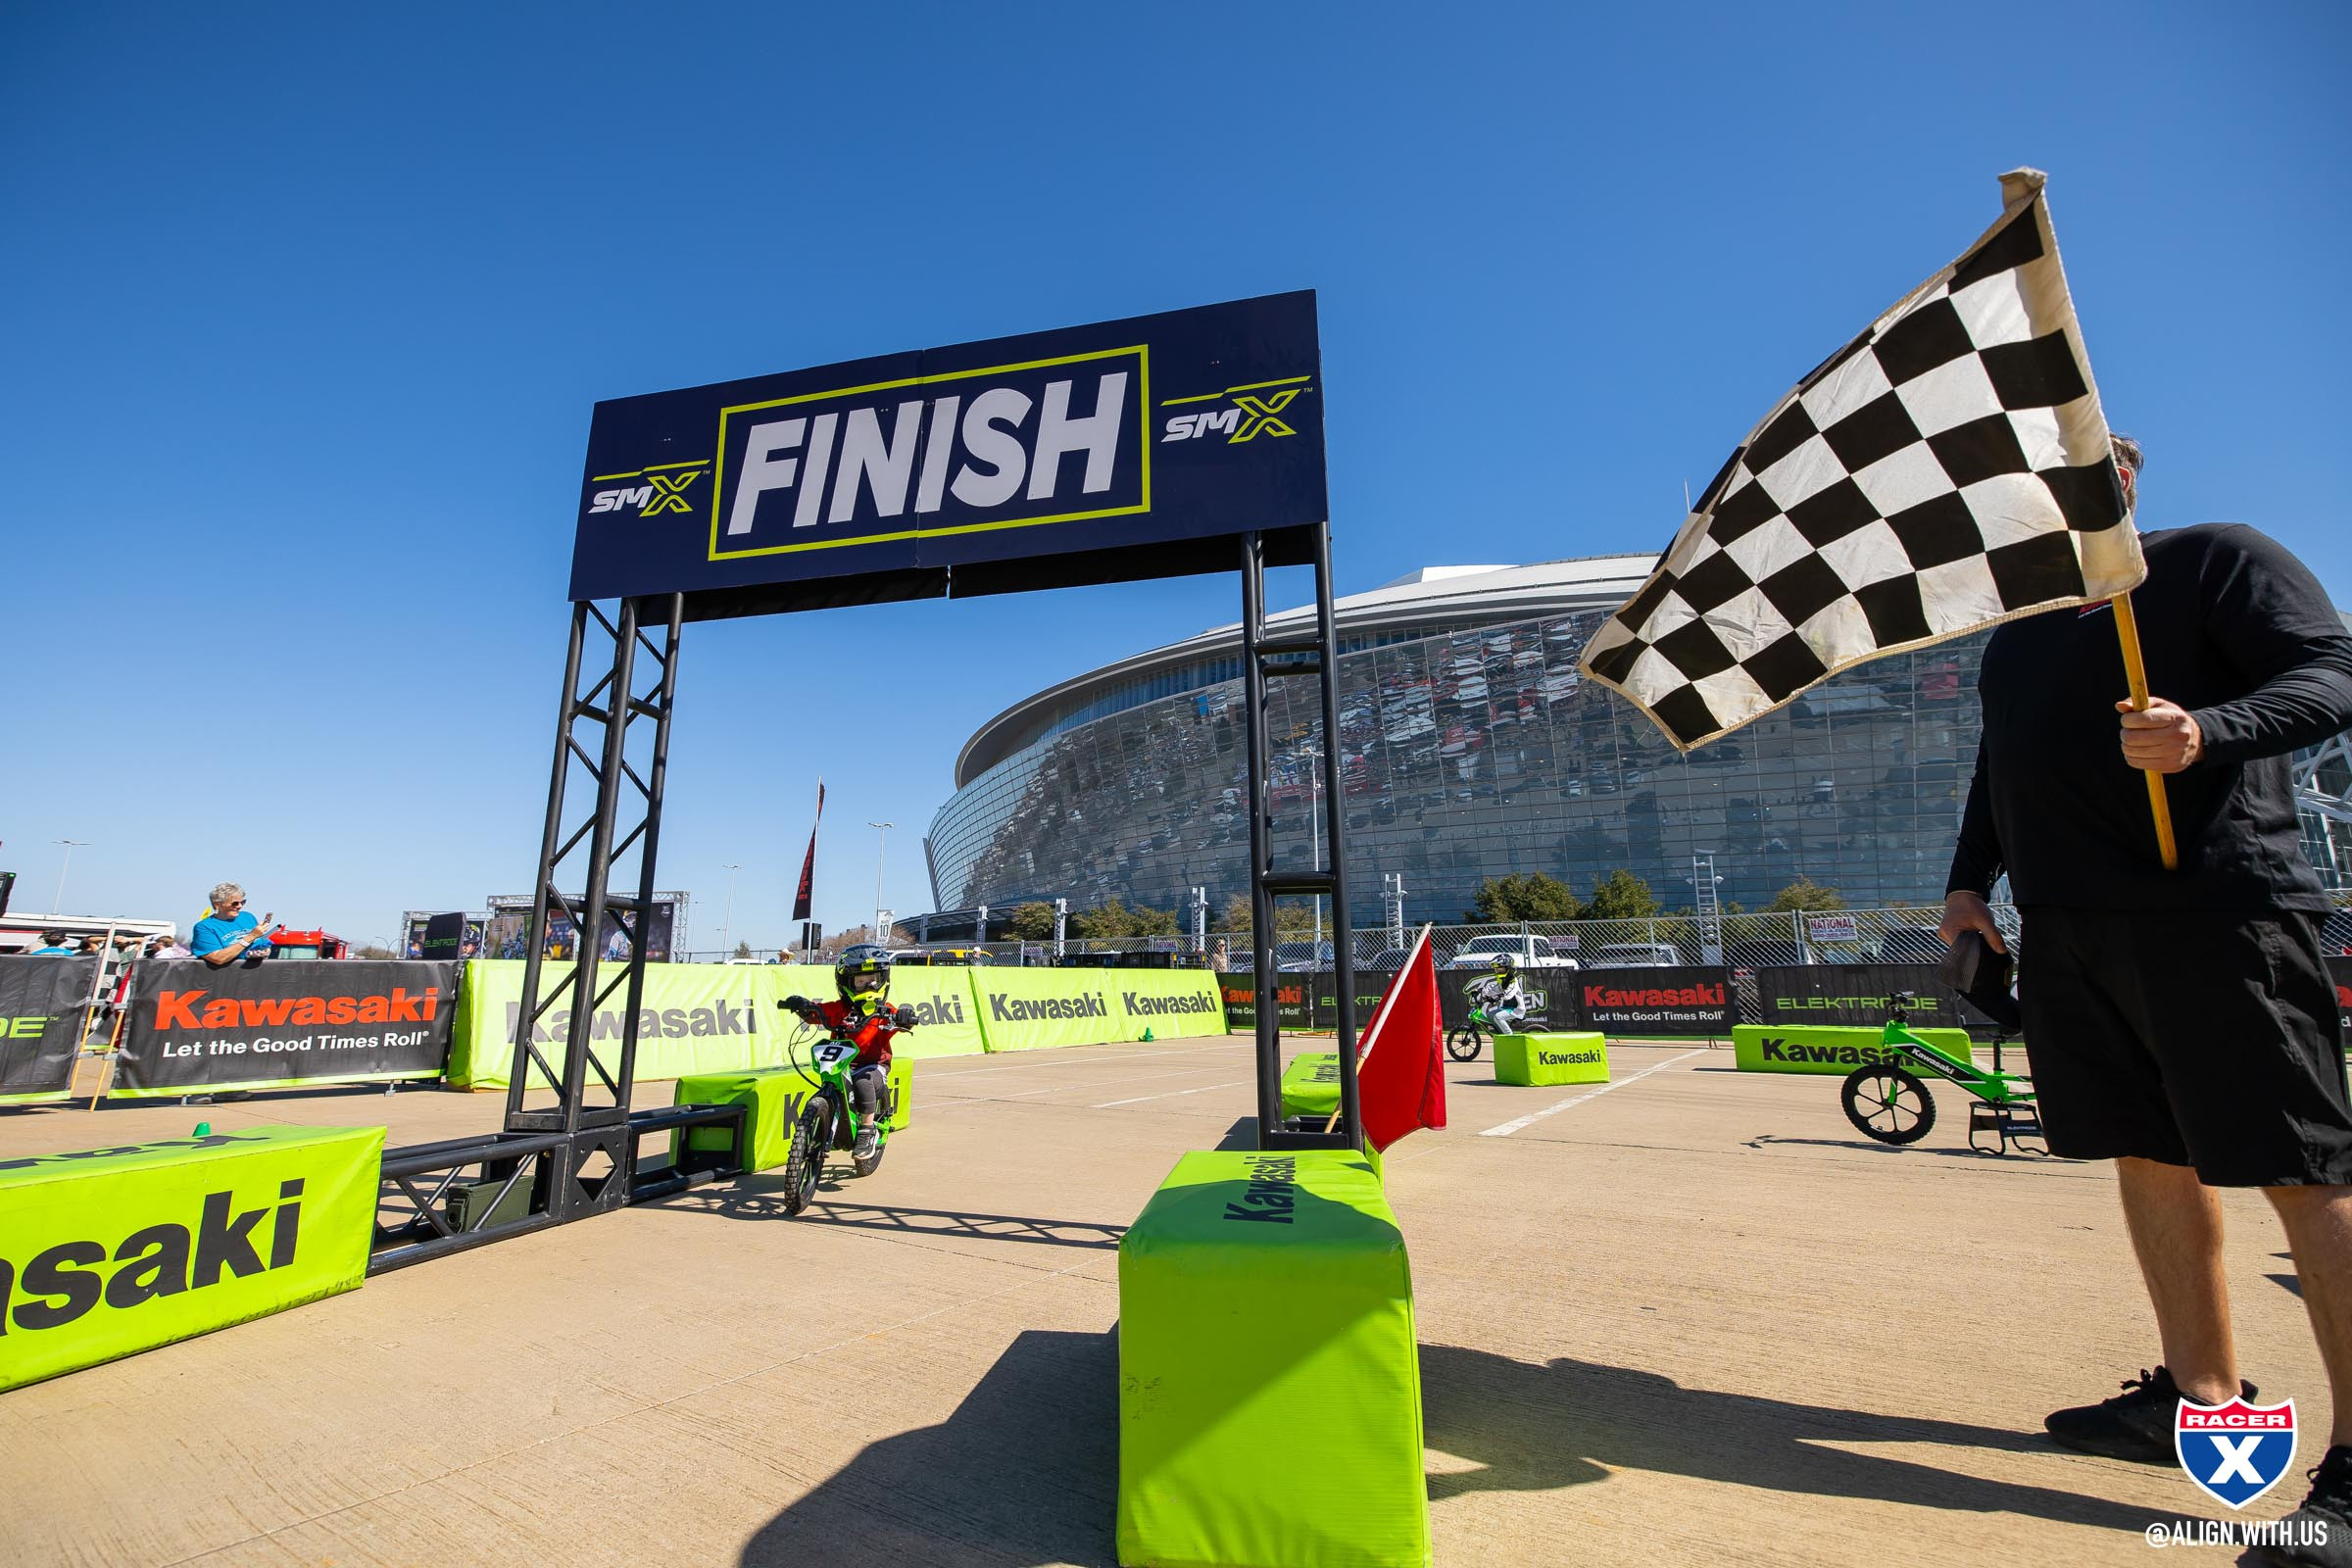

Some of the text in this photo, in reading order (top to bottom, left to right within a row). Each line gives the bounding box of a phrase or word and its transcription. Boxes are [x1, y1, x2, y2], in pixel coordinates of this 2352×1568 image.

[727, 371, 1128, 535] FINISH
[1811, 918, 1855, 930] NATIONAL
[989, 991, 1107, 1021] Kawasaki
[1122, 990, 1217, 1016] Kawasaki
[1584, 982, 1726, 1007] Kawasaki
[155, 987, 439, 1030] Kawasaki
[1593, 1012, 1610, 1021] Let
[1612, 1011, 1629, 1021] the
[1632, 1011, 1661, 1021] Good
[1663, 1011, 1697, 1021] Times
[163, 1041, 202, 1058] Let
[209, 1040, 246, 1055] the
[253, 1036, 312, 1053] Good
[318, 1034, 379, 1050] Times
[820, 1046, 843, 1062] 9
[1539, 1050, 1600, 1065] Kawasaki
[1911, 1048, 1955, 1075] Kawasaki
[1223, 1155, 1296, 1224] Kawasaki
[0, 1178, 305, 1338] saki
